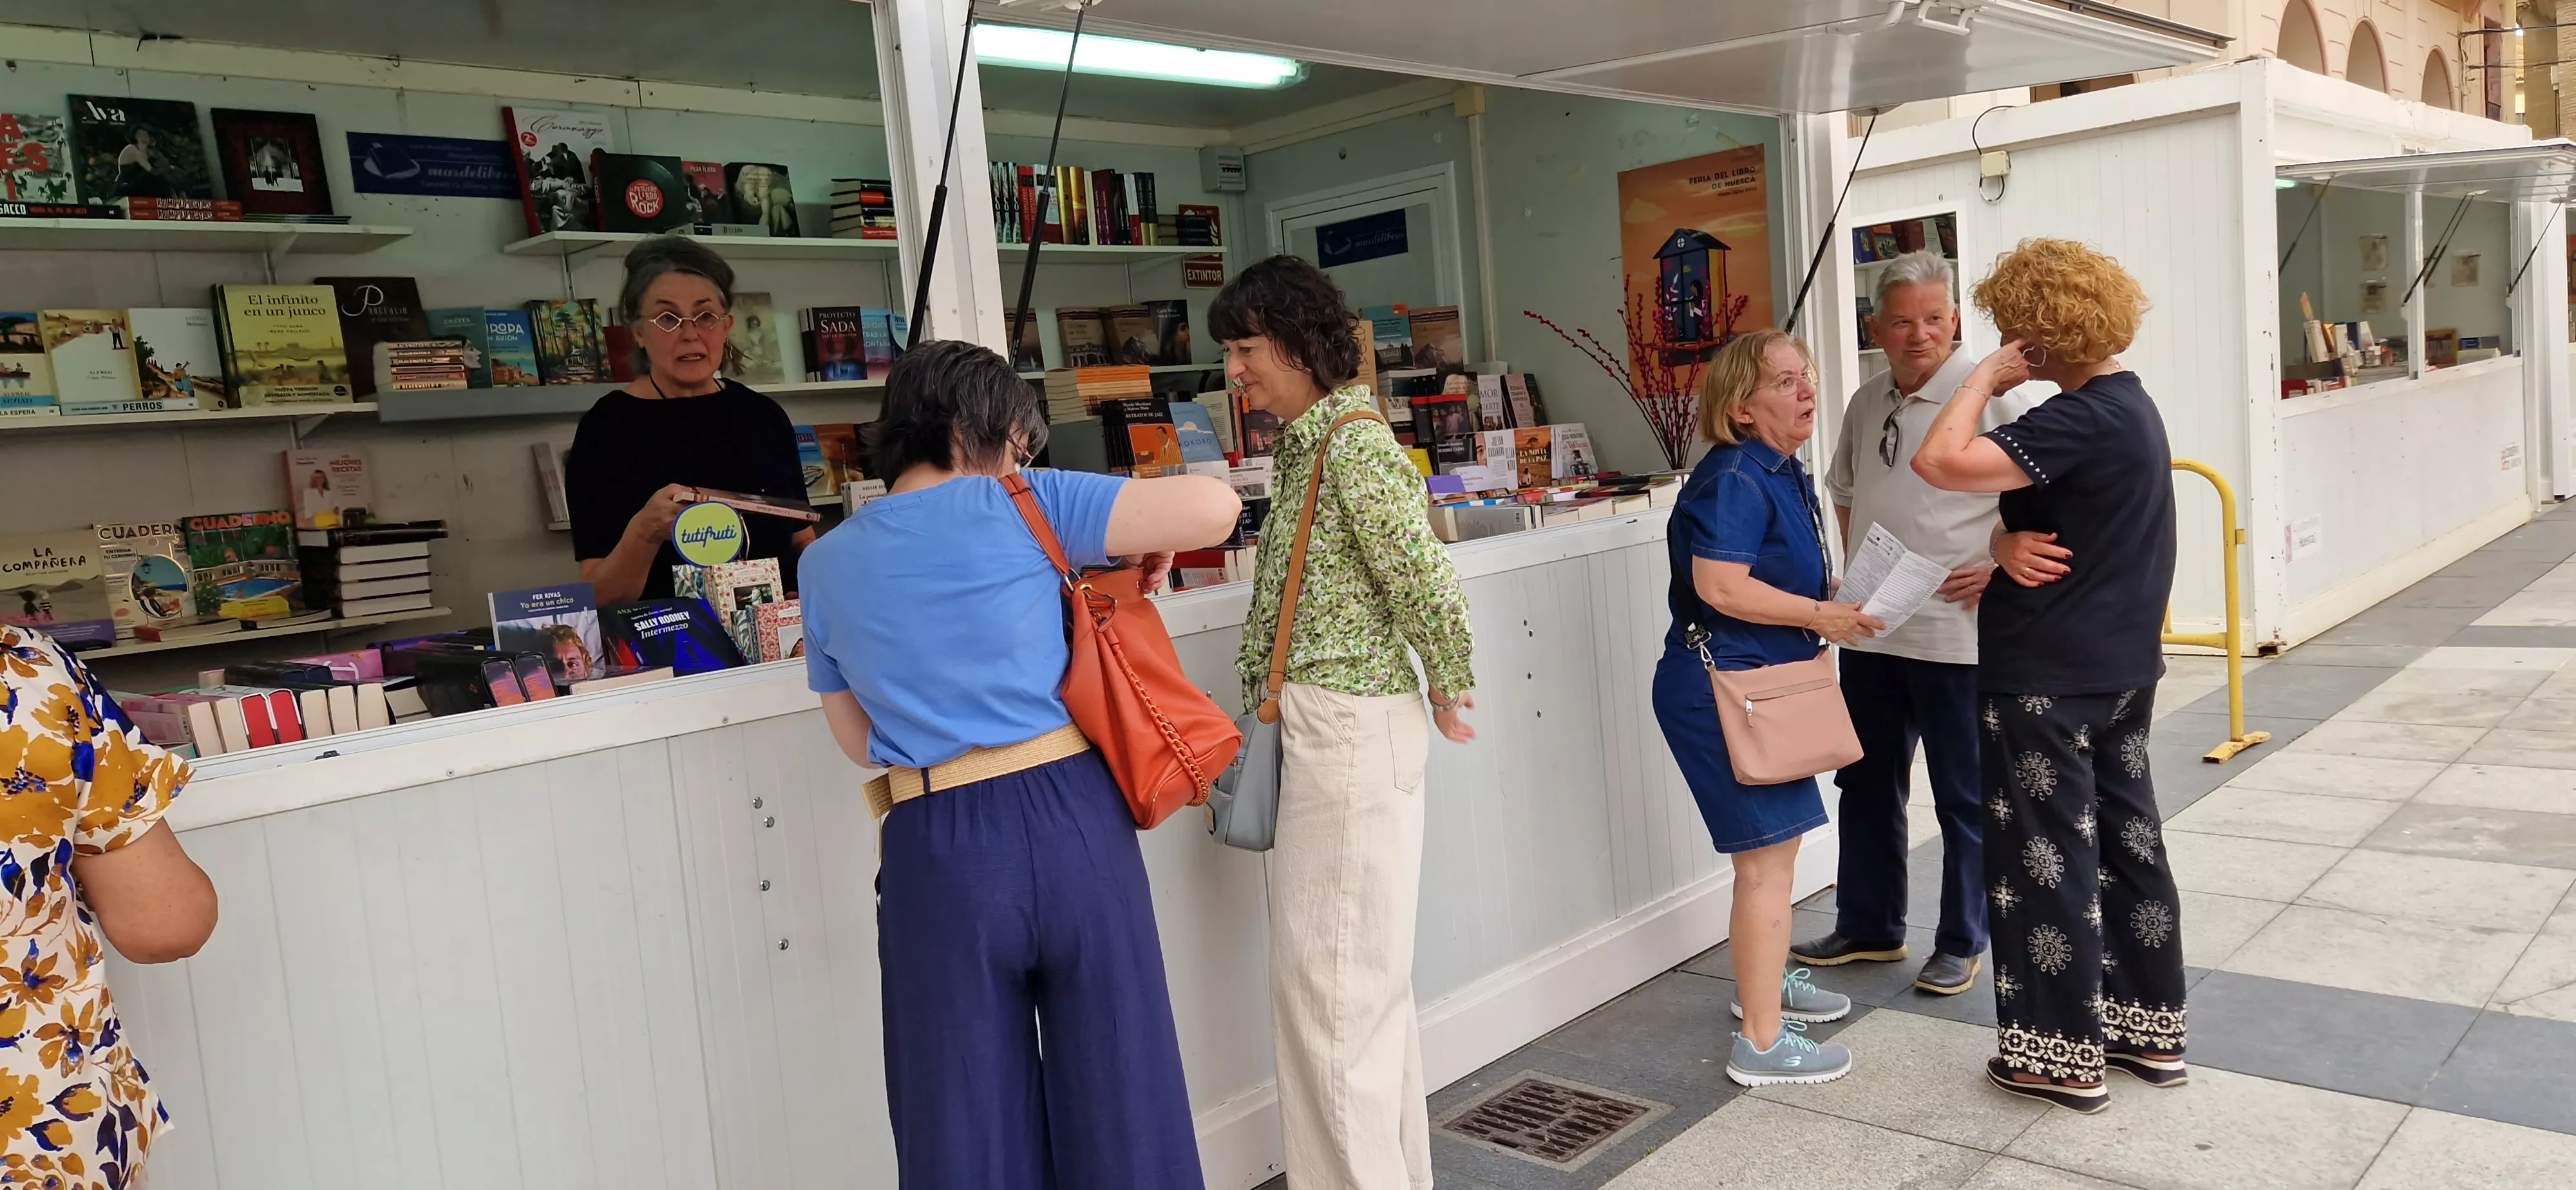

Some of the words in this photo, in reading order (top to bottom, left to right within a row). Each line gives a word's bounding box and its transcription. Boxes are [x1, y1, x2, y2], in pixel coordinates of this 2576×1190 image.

[1689, 175, 1711, 185] FERIA
[1714, 172, 1728, 180] DEL
[1732, 166, 1756, 176] LIBRO
[1725, 176, 1756, 187] HUESCA
[629, 191, 659, 214] ROCK
[1187, 269, 1222, 282] EXTINTOR
[248, 295, 263, 305] El
[267, 294, 319, 305] infinito
[244, 307, 261, 317] en
[265, 307, 283, 317] un
[287, 306, 327, 319] junco
[486, 323, 525, 335] ROPA
[820, 319, 857, 333] SADA
[1481, 389, 1499, 399] MOR
[122, 401, 162, 411] PERROS
[1179, 437, 1212, 448] KOKORO
[1529, 448, 1548, 457] NOVIA
[1536, 455, 1548, 463] PAZ
[190, 511, 290, 531] CUADERNO
[98, 524, 182, 540] CUADERN
[681, 525, 737, 547] tutifruti
[33, 547, 53, 558] LA
[3, 555, 87, 573] COMPAÑERA
[556, 596, 574, 605] chico
[634, 618, 659, 632] SALLY
[659, 611, 690, 626] ROONEY
[641, 621, 688, 639] Intermezzo
